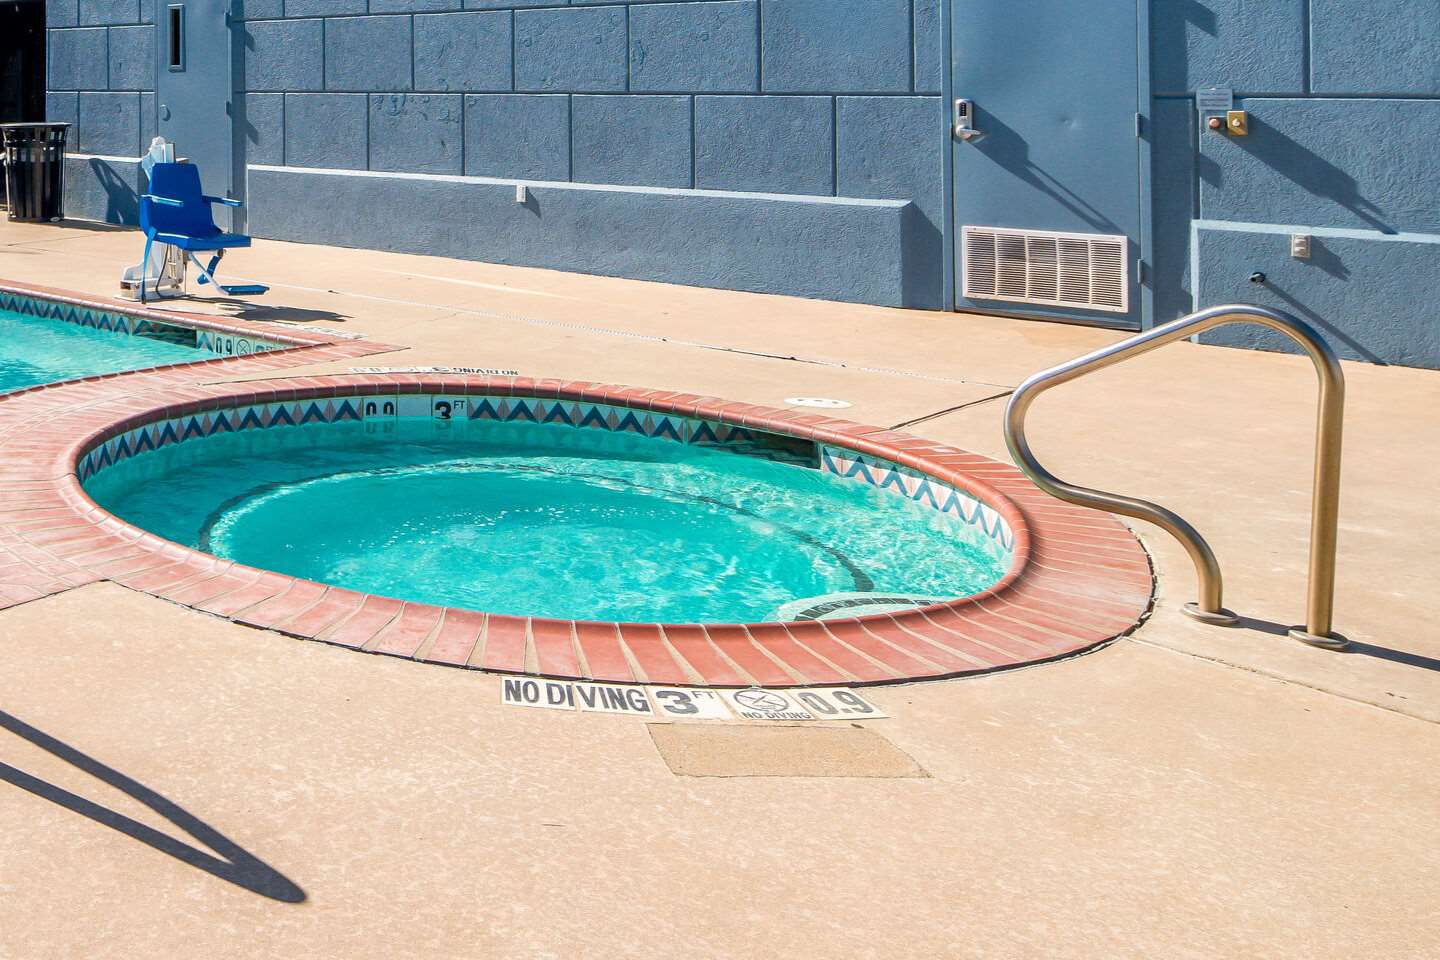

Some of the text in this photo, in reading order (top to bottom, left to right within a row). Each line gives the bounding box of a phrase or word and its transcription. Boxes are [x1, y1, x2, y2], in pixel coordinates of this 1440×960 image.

[504, 679, 715, 715] NO DIVING 3 FT
[740, 711, 812, 719] NO DIVING
